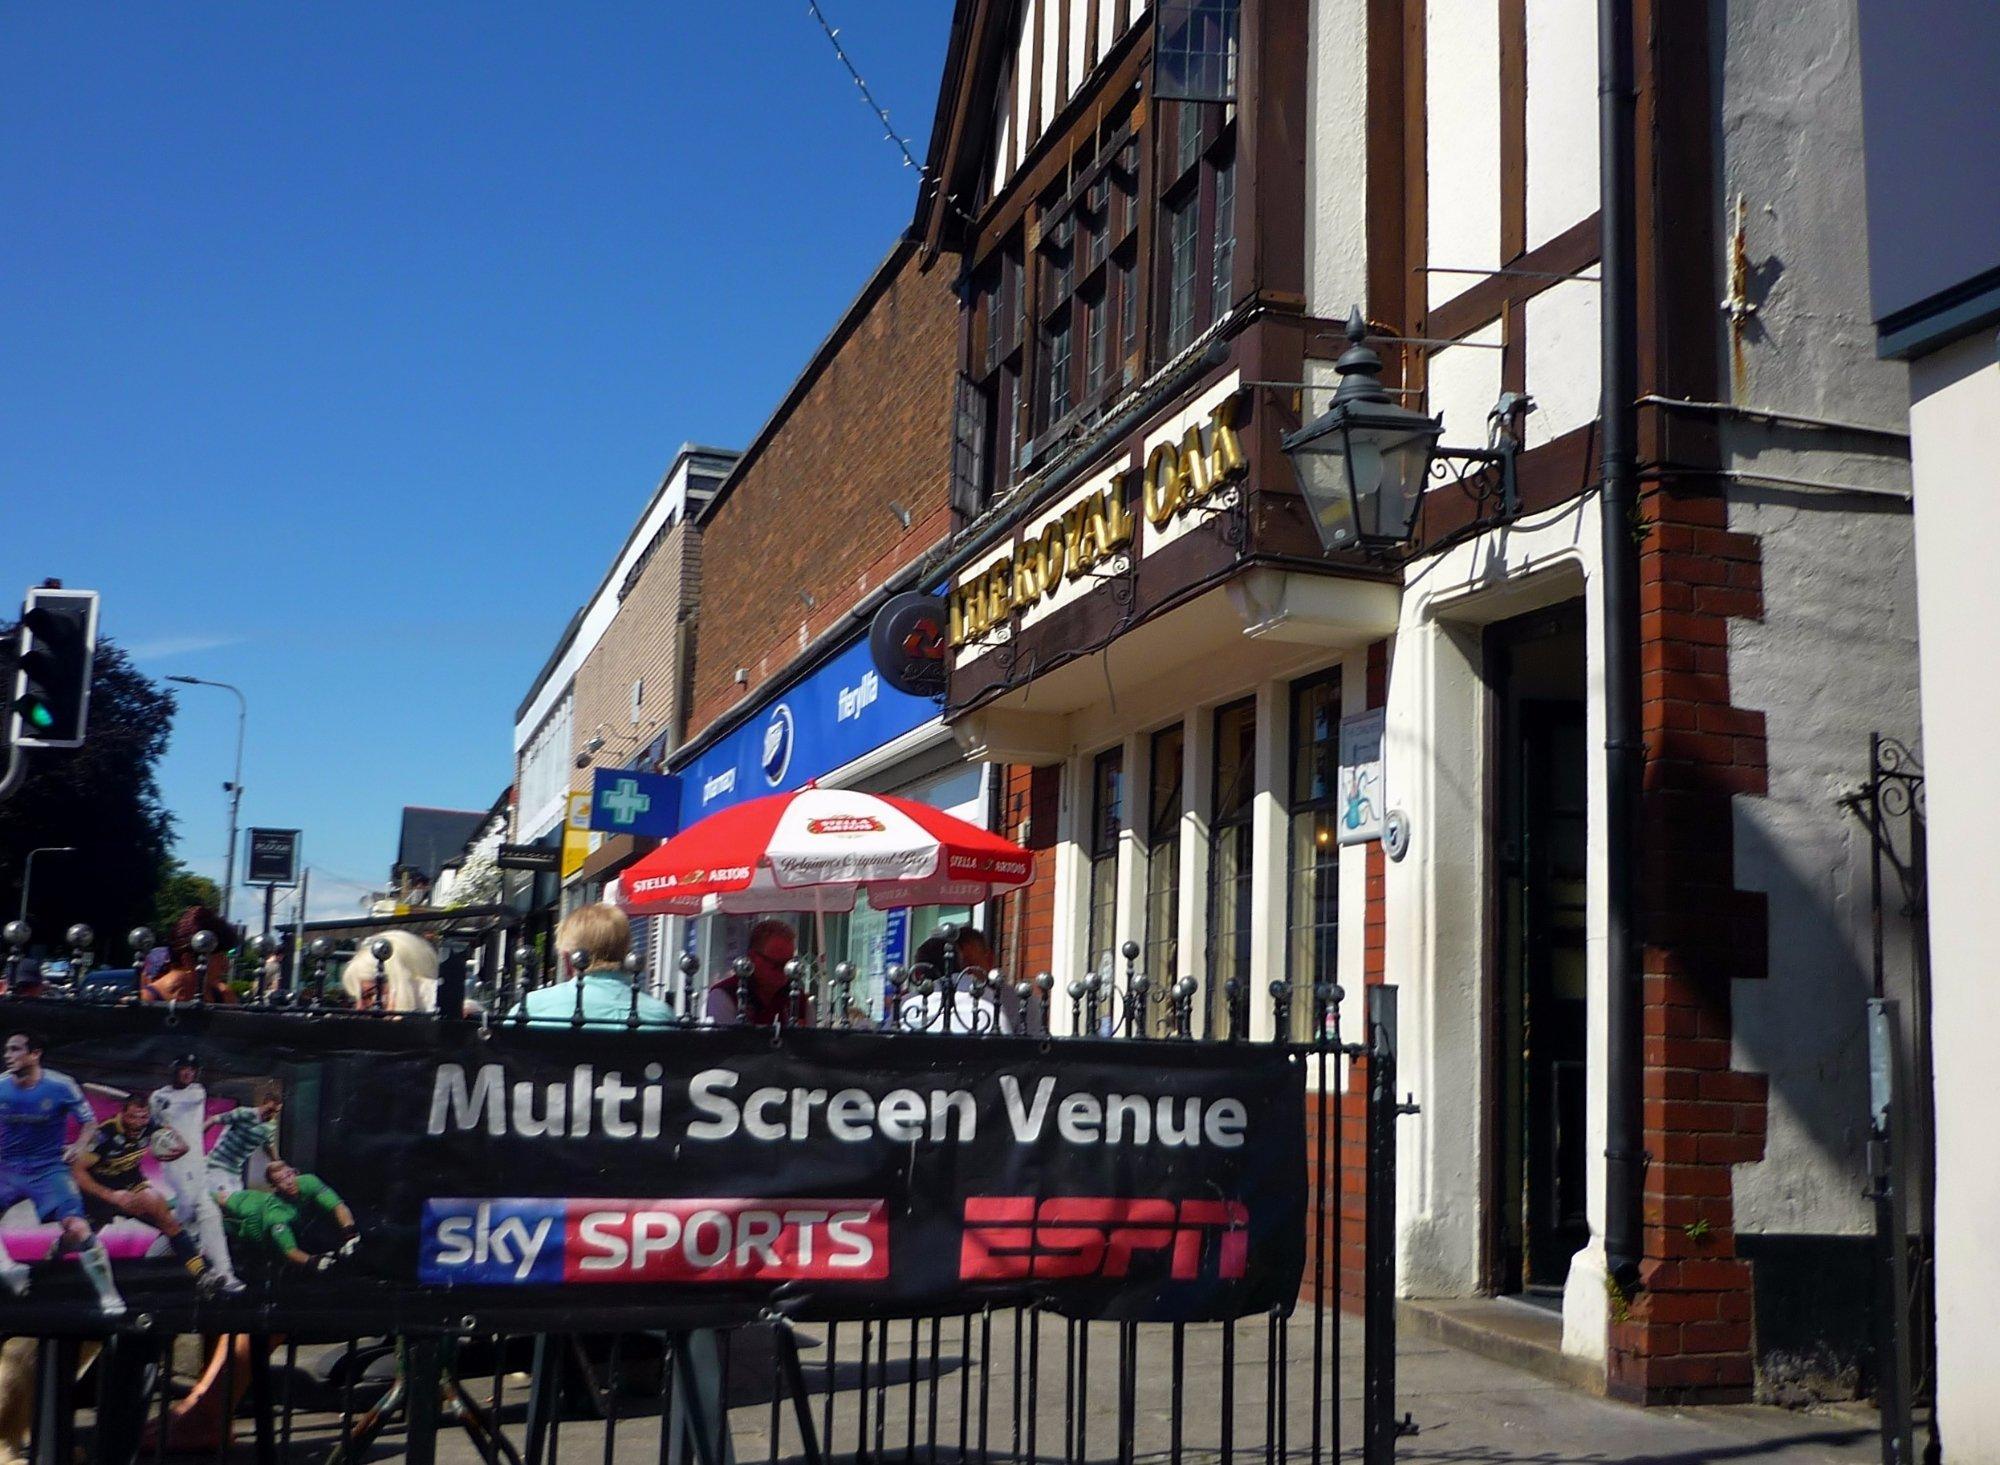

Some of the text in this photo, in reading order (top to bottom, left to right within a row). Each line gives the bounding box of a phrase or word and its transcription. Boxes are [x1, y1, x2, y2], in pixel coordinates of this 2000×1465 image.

[1012, 473, 1135, 609] ROYAL
[1143, 388, 1250, 529] OAK
[632, 866, 750, 893] STELLA ARTOIS
[950, 855, 1026, 875] STELLA ARTOIS
[427, 1063, 1248, 1148] Multi Screen Venue
[435, 1203, 875, 1279] sky SPORTS
[958, 1195, 1249, 1281] ESPN
